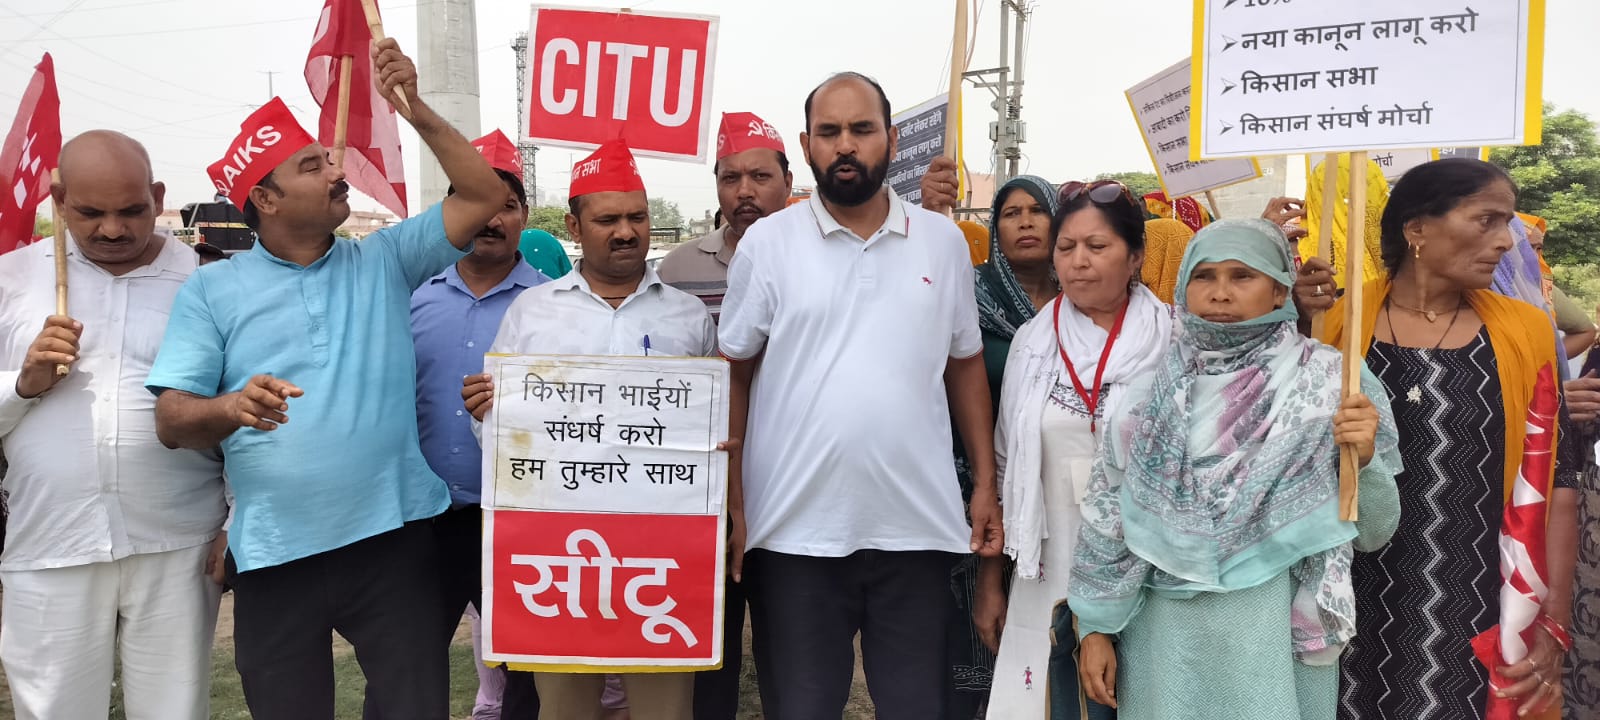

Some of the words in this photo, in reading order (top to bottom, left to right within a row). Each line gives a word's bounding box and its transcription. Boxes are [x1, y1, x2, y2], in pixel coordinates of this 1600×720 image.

[1241, 29, 1289, 50] नया
[1294, 22, 1366, 51] कानून
[1371, 17, 1427, 45] लागू
[1430, 7, 1479, 34] करो
[540, 37, 698, 127] CITU
[1241, 70, 1321, 94] किसान
[1326, 66, 1379, 88] सभा
[1240, 113, 1312, 135] किसान
[1317, 104, 1373, 131] संघर्ष
[1377, 101, 1433, 126] मोर्चा
[223, 125, 282, 188] AIKS
[522, 372, 605, 405] किसान
[618, 379, 692, 411] भाईयों
[617, 417, 666, 445] करो
[510, 457, 546, 481] हम
[559, 454, 630, 490] तुम्हारे
[643, 462, 697, 485] साथ
[511, 528, 698, 648] सीटू
